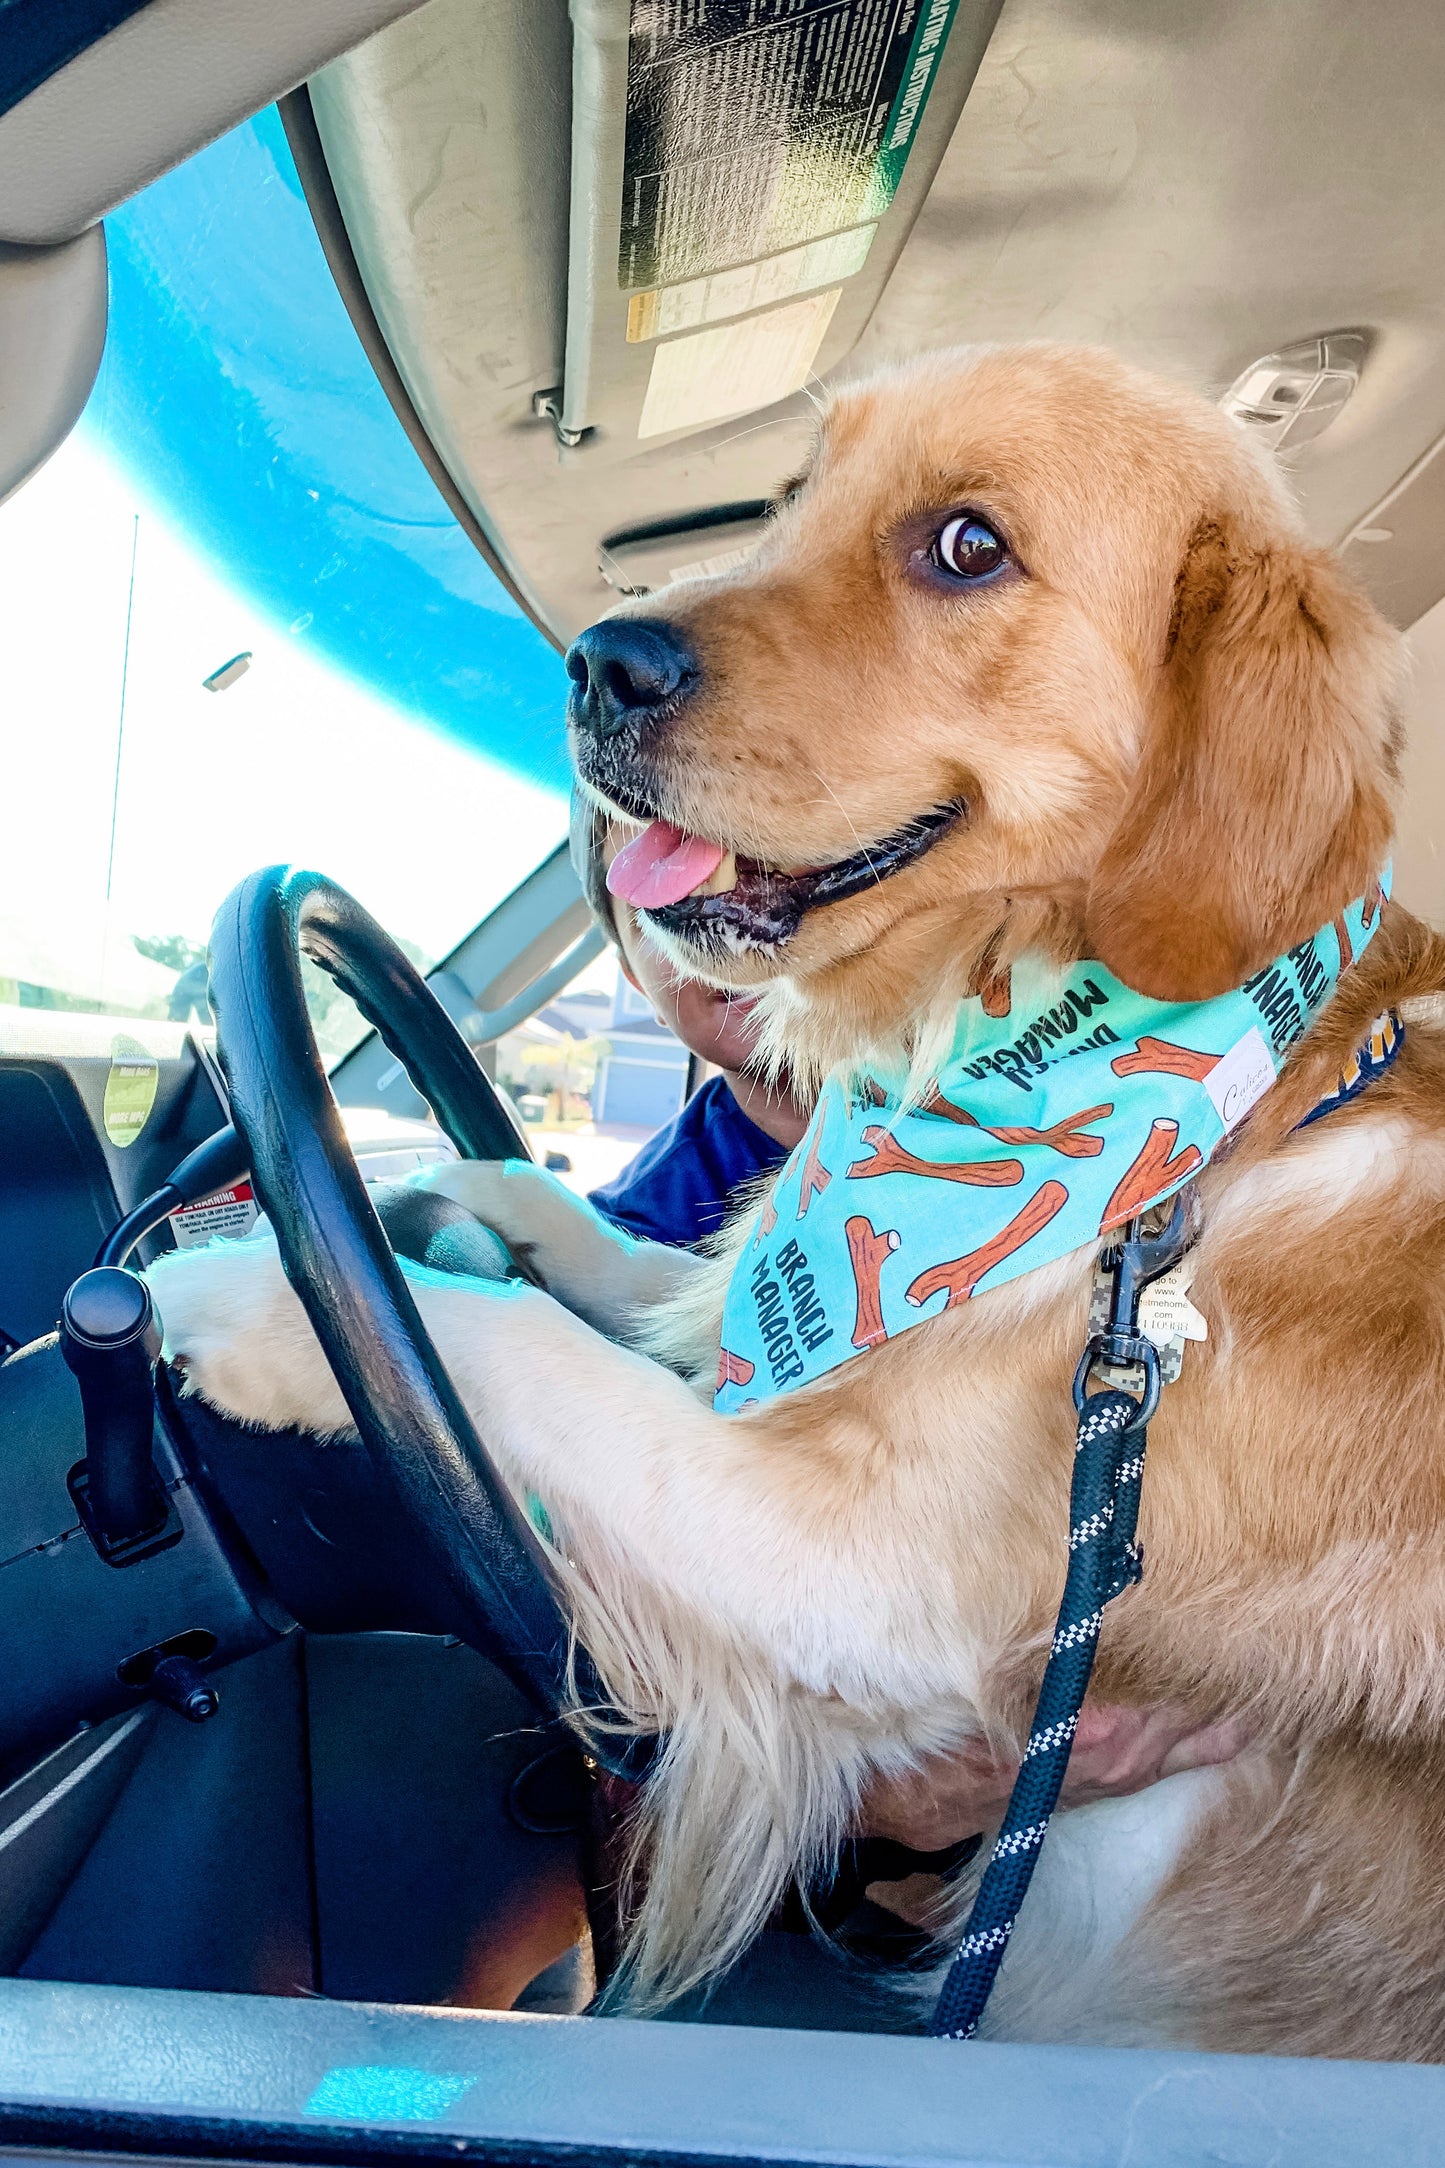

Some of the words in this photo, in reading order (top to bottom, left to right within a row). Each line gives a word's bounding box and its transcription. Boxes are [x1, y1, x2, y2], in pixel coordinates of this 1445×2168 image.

[888, 51, 936, 150] INSTRUCTIONS
[750, 1252, 804, 1392] MANAGER
[775, 1237, 834, 1353] BRANCH
